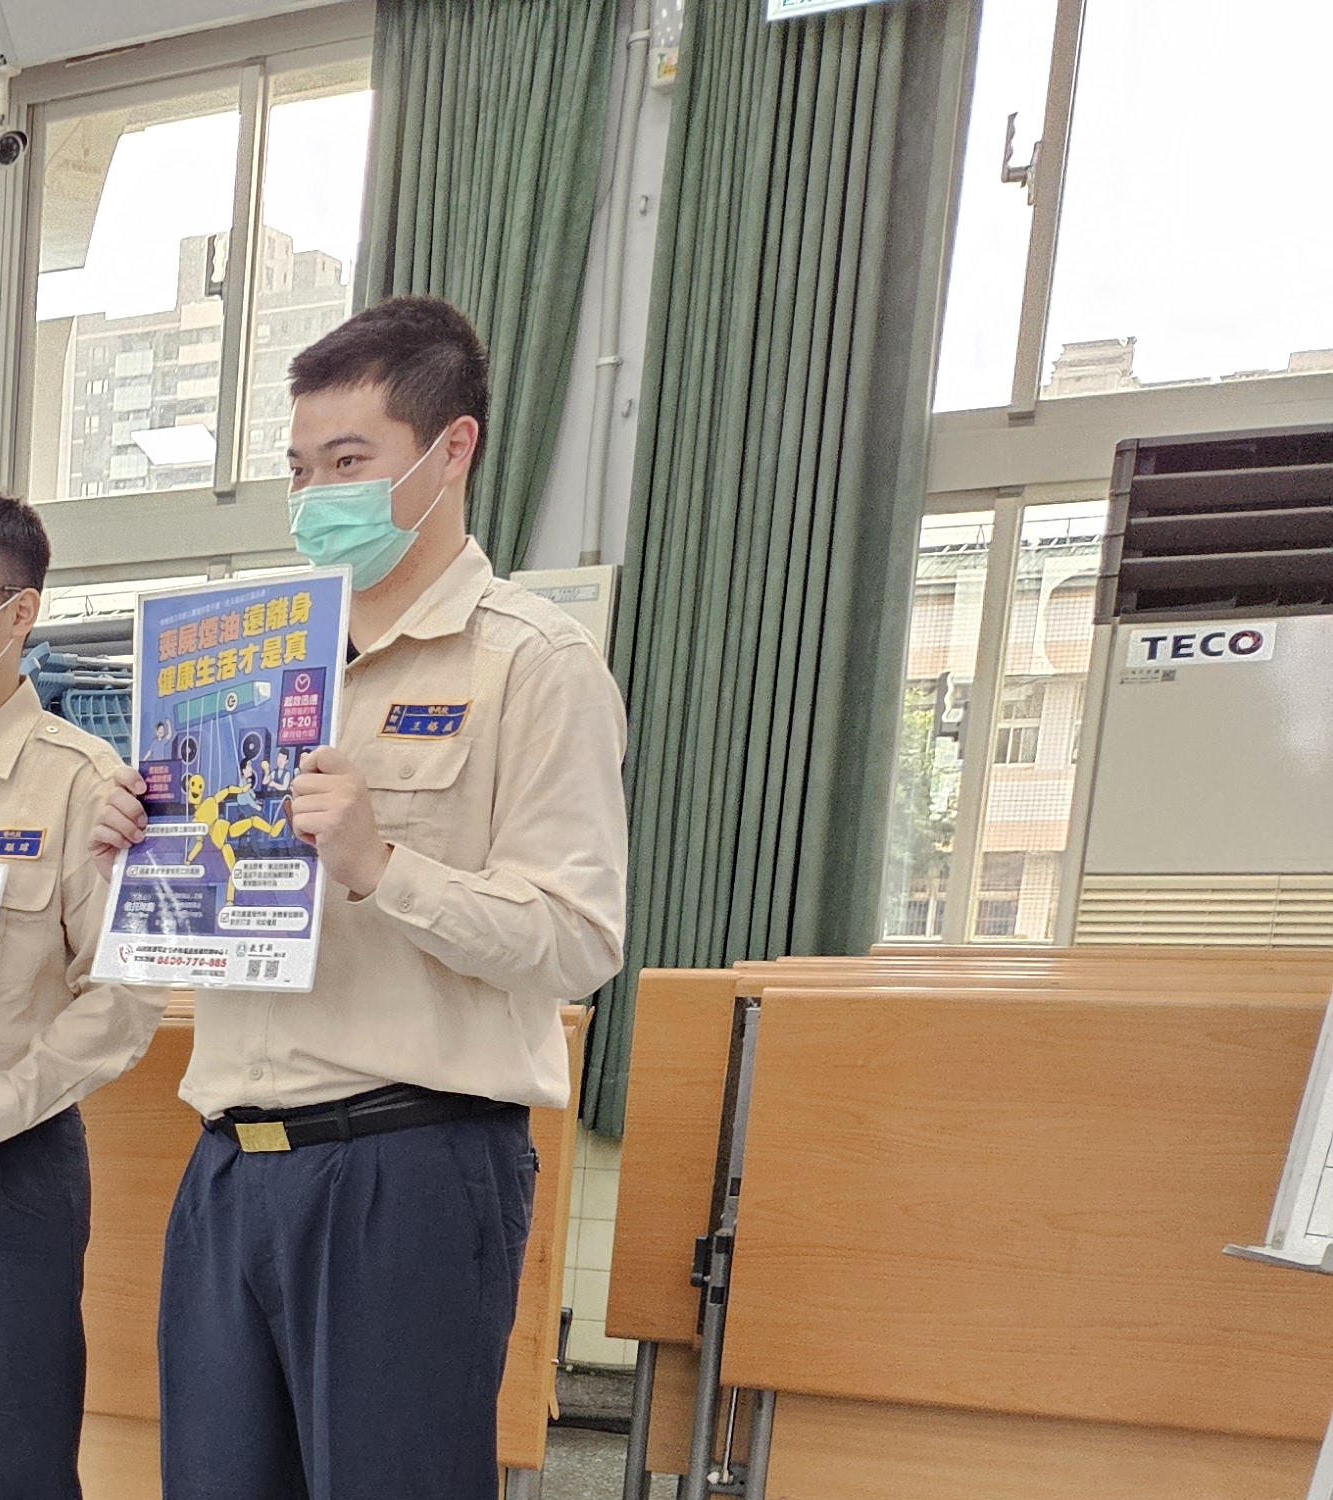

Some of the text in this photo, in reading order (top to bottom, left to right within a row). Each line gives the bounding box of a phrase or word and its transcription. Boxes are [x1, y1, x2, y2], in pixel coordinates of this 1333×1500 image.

[1141, 629, 1264, 661] TECO
[157, 630, 309, 698] 健康生活才是真
[282, 716, 312, 728] 15-20
